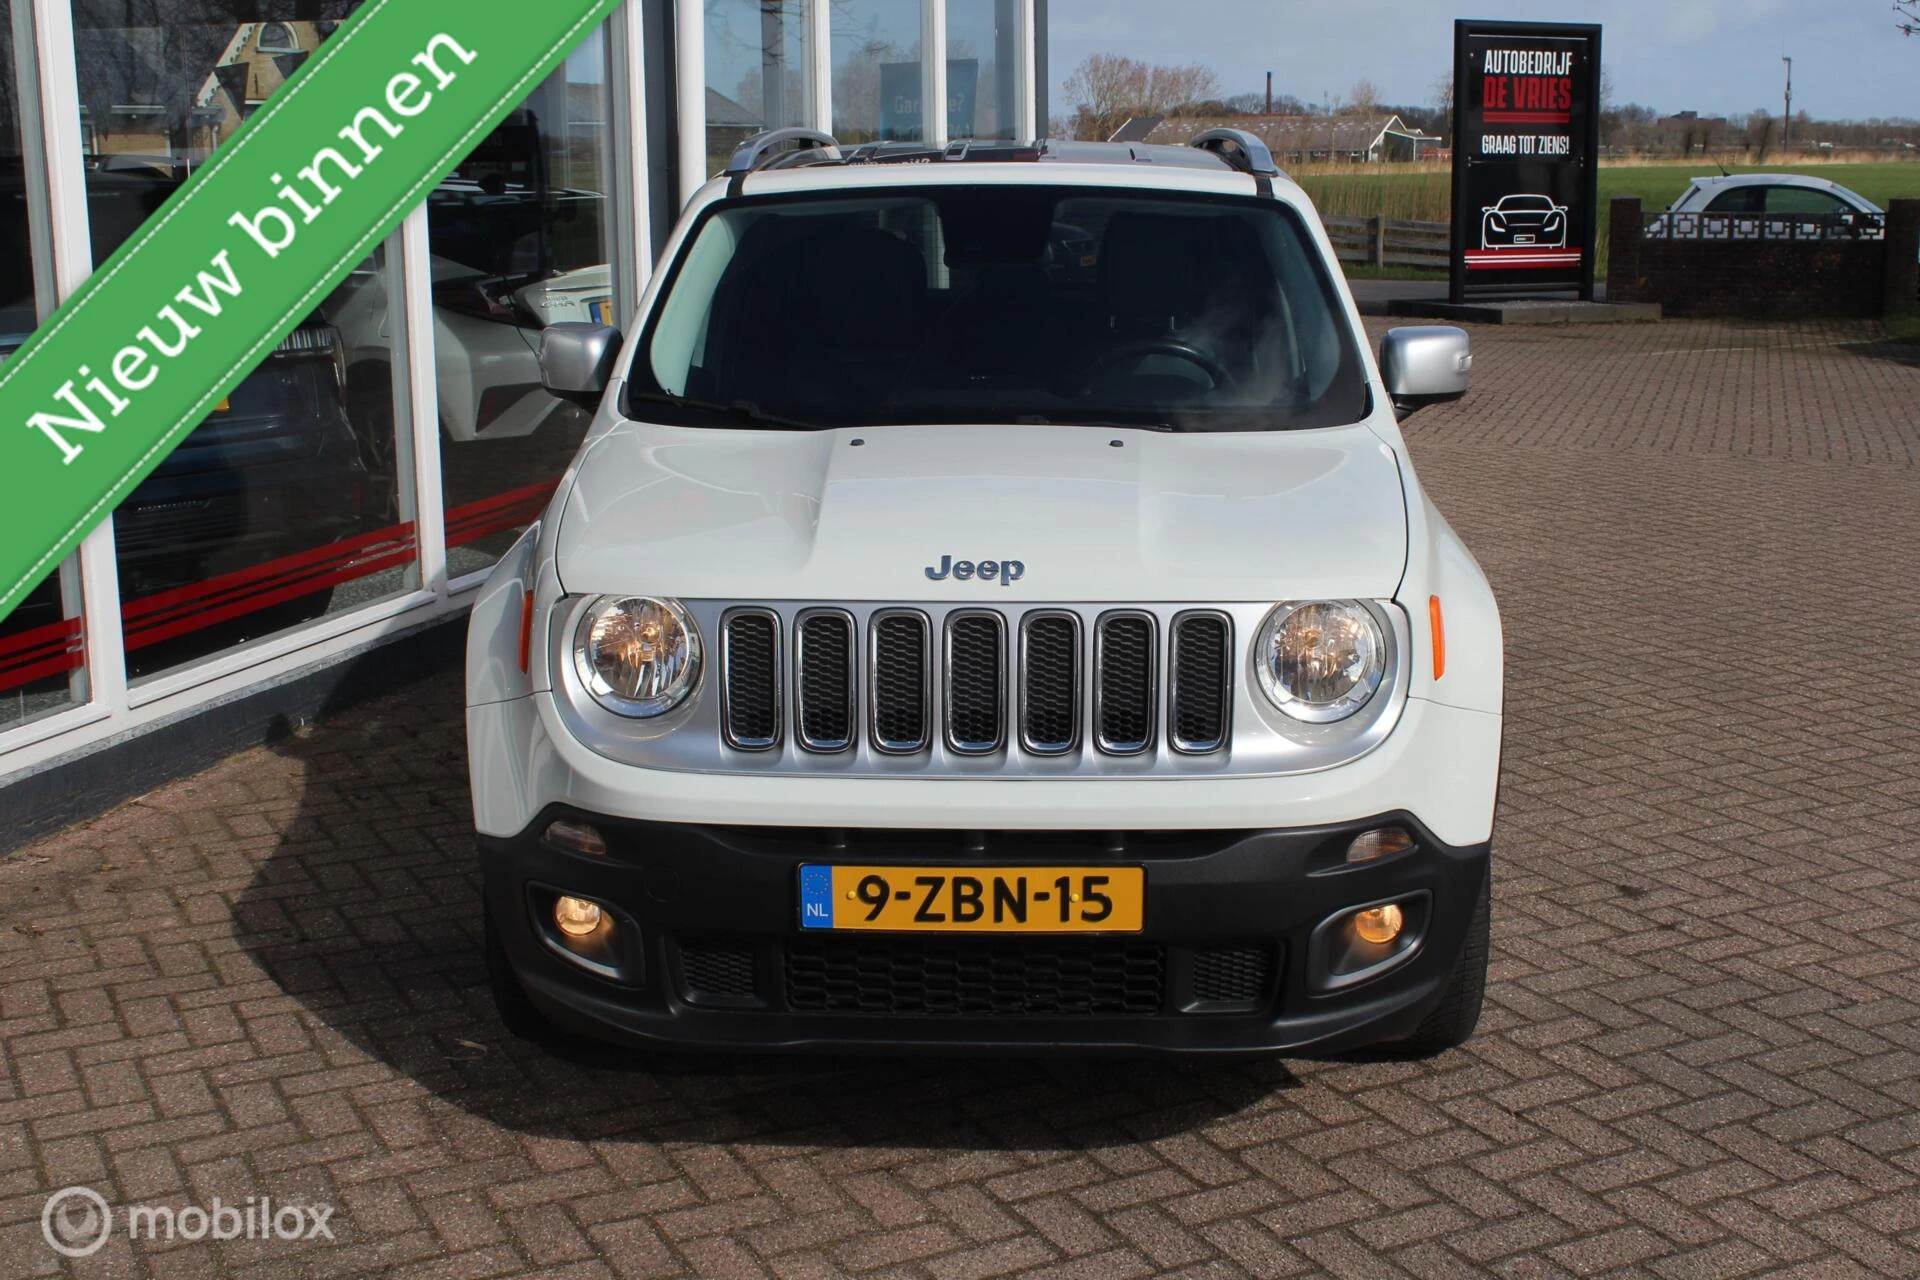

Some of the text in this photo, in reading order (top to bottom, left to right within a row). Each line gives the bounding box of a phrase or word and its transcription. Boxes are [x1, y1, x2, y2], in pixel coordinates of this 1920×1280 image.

[1484, 49, 1573, 76] AUTOBEDRIJF
[1483, 76, 1572, 110] DE VRIES
[1482, 134, 1569, 155] GRAAG TOT ZIENS!
[924, 555, 1025, 586] Jeep
[806, 903, 829, 918] NL
[856, 874, 1113, 923] 9-ZBN-15
